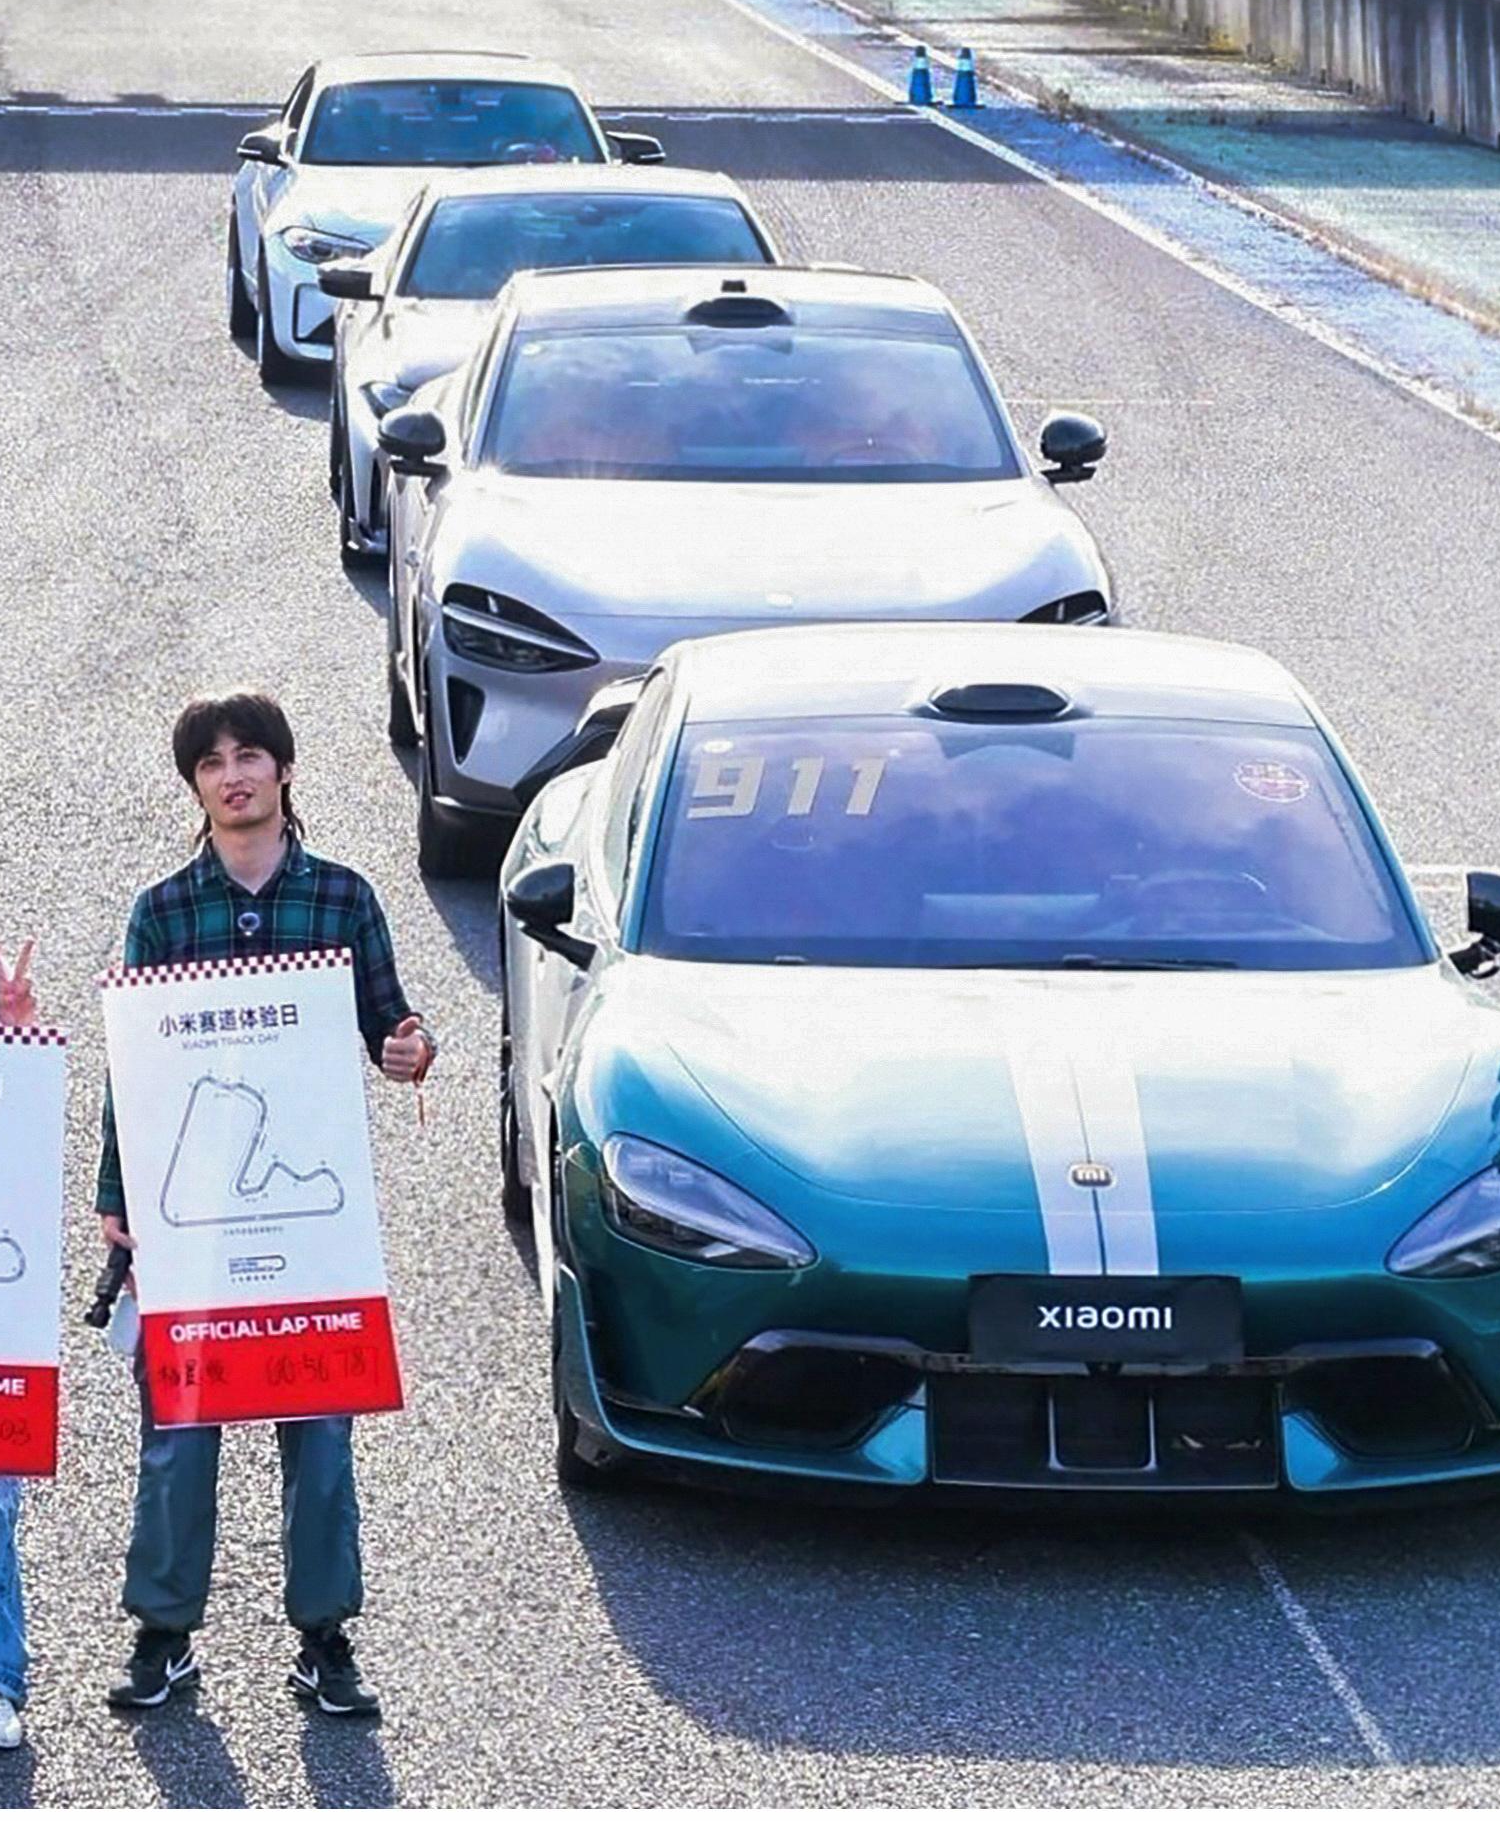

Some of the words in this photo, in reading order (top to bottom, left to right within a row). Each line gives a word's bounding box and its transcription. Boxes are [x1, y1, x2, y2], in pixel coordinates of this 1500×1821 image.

[686, 756, 887, 820] 911
[158, 1004, 299, 1038] 小米赛道体验日
[170, 1320, 265, 1343] OFFICIAL
[267, 1315, 310, 1336] LAP
[312, 1312, 363, 1332] TIME
